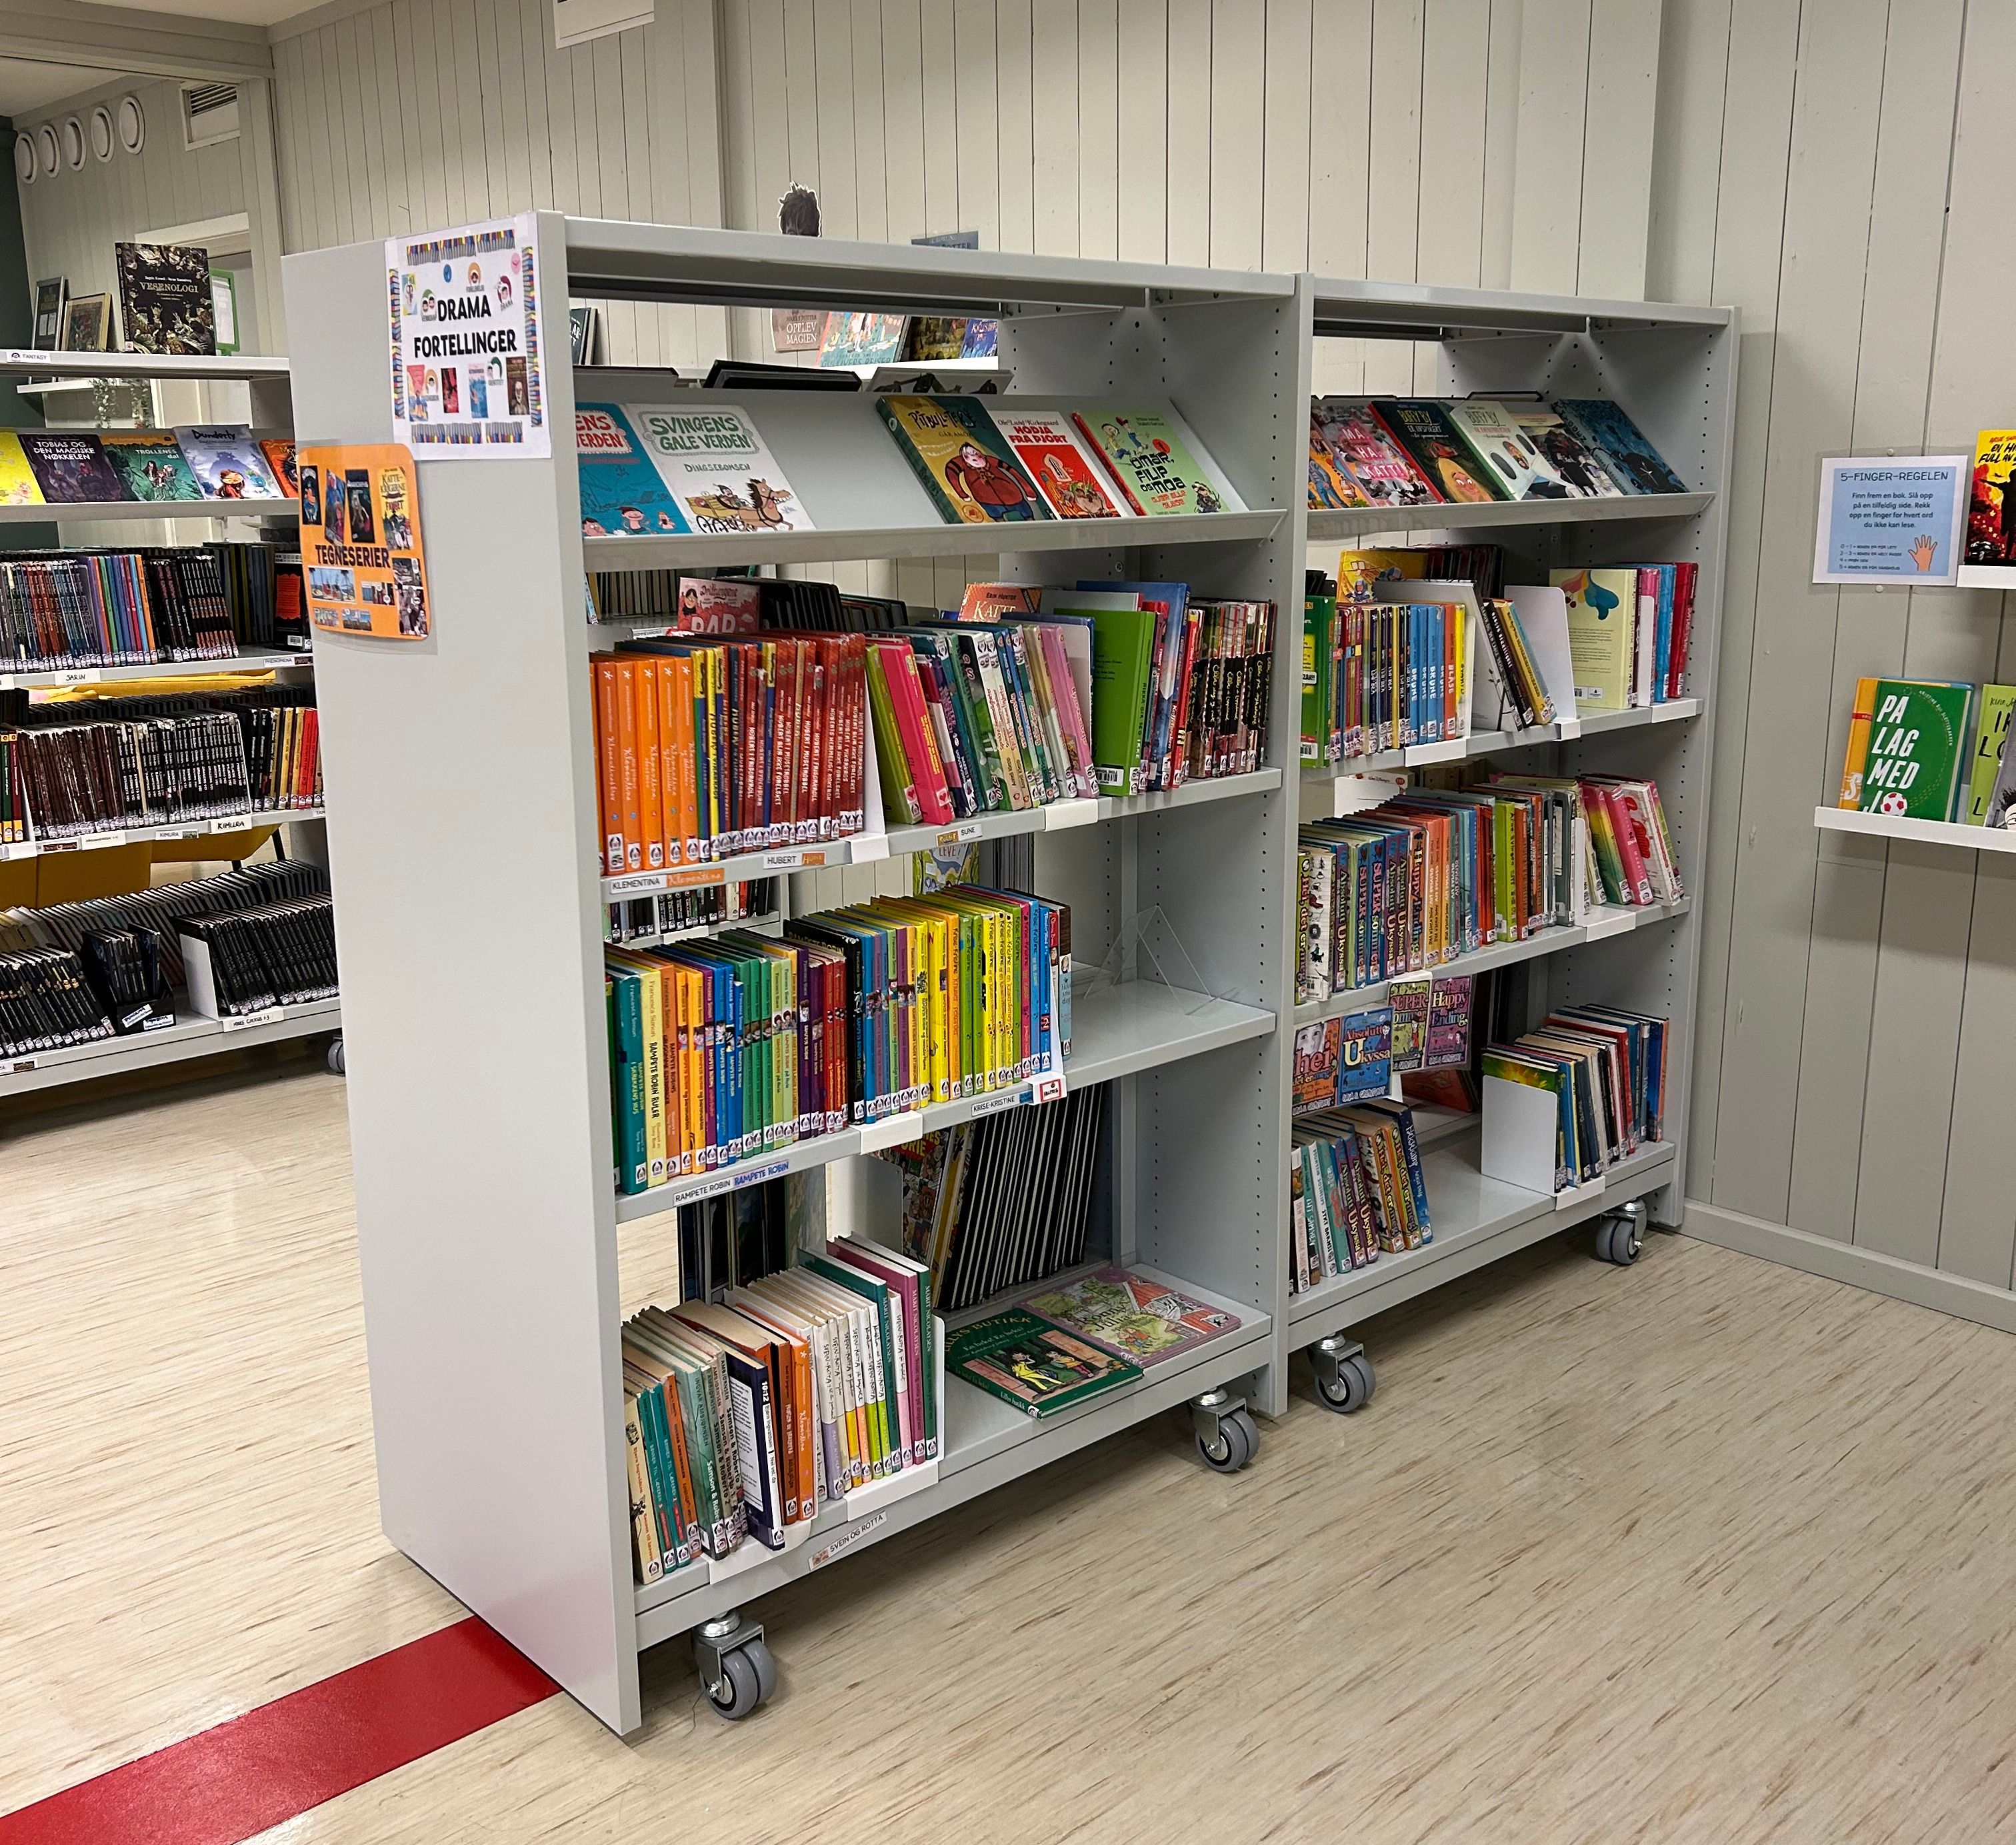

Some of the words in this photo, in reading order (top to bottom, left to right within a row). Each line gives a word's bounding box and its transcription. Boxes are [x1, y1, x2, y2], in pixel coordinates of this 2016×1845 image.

[139, 281, 199, 293] VESENOLOGI
[437, 295, 492, 322] DRAMA
[787, 322, 817, 333] OPPLEV
[413, 329, 517, 359] FORTELLINGER
[787, 333, 818, 344] MAGIEN
[23, 353, 47, 361] FANTASY
[650, 416, 740, 436] SVINGENS
[1013, 426, 1053, 434] HODJA
[659, 434, 700, 451] GALE
[699, 433, 752, 449] VERDEN
[1008, 435, 1034, 443] FRA
[1035, 435, 1069, 443] PJORT
[1991, 443, 2004, 453] EN
[683, 463, 751, 473] DINGSEBOMSEN
[1978, 453, 2001, 463] FULL
[2002, 453, 2015, 462] AV
[1135, 465, 1168, 483] FILIP
[1363, 465, 1405, 479] KATT!
[1841, 471, 1949, 481] 5-FINGER-REGELEN
[315, 544, 391, 568] TEGNESERIER
[66, 673, 86, 681] SARIN
[1411, 667, 1419, 702] BRUNE
[1429, 665, 1437, 699] BRUNE
[1871, 726, 1920, 757] LAG
[1867, 758, 1921, 789] MED
[217, 821, 245, 829] KIMURA
[961, 827, 975, 836] SUNE
[767, 855, 797, 865] HUBERT
[612, 877, 661, 890] KLEMENTINA
[1399, 856, 1409, 911] Absolutt
[1411, 849, 1425, 900] Happy
[1339, 869, 1350, 924] Absolutt
[1371, 861, 1383, 917] SUPER
[1389, 859, 1397, 914] Absolutt
[1300, 907, 1309, 932] det
[1411, 899, 1423, 954] Ending
[1299, 933, 1307, 949] er
[1386, 913, 1397, 962] Ukyssa
[1397, 909, 1407, 956] Ukyssa
[1337, 924, 1347, 972] Ukyssa
[1389, 993, 1429, 1011] SUPER-
[1433, 990, 1471, 1009] Happy
[1044, 1018, 1050, 1030] 2
[1431, 1012, 1468, 1028] Ending
[1345, 1025, 1384, 1041] Absolutt
[649, 1042, 659, 1073] RAMPETE
[1343, 1037, 1392, 1067] Ukyssa
[650, 1074, 659, 1095] ROBIN
[651, 1097, 660, 1119] RULER
[973, 1097, 1016, 1112] KRISE-KRISTINE
[675, 1187, 708, 1202] RAMPETE
[709, 1179, 731, 1195] ROBIN
[734, 1168, 766, 1186] RAMPETE
[767, 1161, 790, 1178] ROBIN
[1341, 1162, 1354, 1212] Absolutt
[1353, 1158, 1367, 1206] Absolutt
[1383, 1174, 1392, 1194] det
[1399, 1168, 1409, 1188] det
[1386, 1195, 1395, 1210] er
[1403, 1186, 1413, 1204] er
[1347, 1206, 1361, 1252] Ukyssa
[1359, 1204, 1373, 1247] Ukyssa
[971, 1316, 1033, 1331] BUTIKK
[1077, 1303, 1128, 1329] Ronny
[883, 1320, 893, 1363] NICOLAYSEN
[726, 1407, 735, 1436] Samson
[730, 1436, 737, 1445] &
[713, 1422, 722, 1454] Samson
[720, 1462, 730, 1498] Roberto
[719, 1413, 728, 1446] Samson
[725, 1454, 735, 1490] Roberto
[731, 1446, 740, 1480] Roberto
[706, 1460, 717, 1491] Samson
[712, 1490, 719, 1499] &
[830, 1536, 850, 1553] SVEIN
[850, 1528, 861, 1540] OG
[861, 1514, 883, 1532] ROTTA
